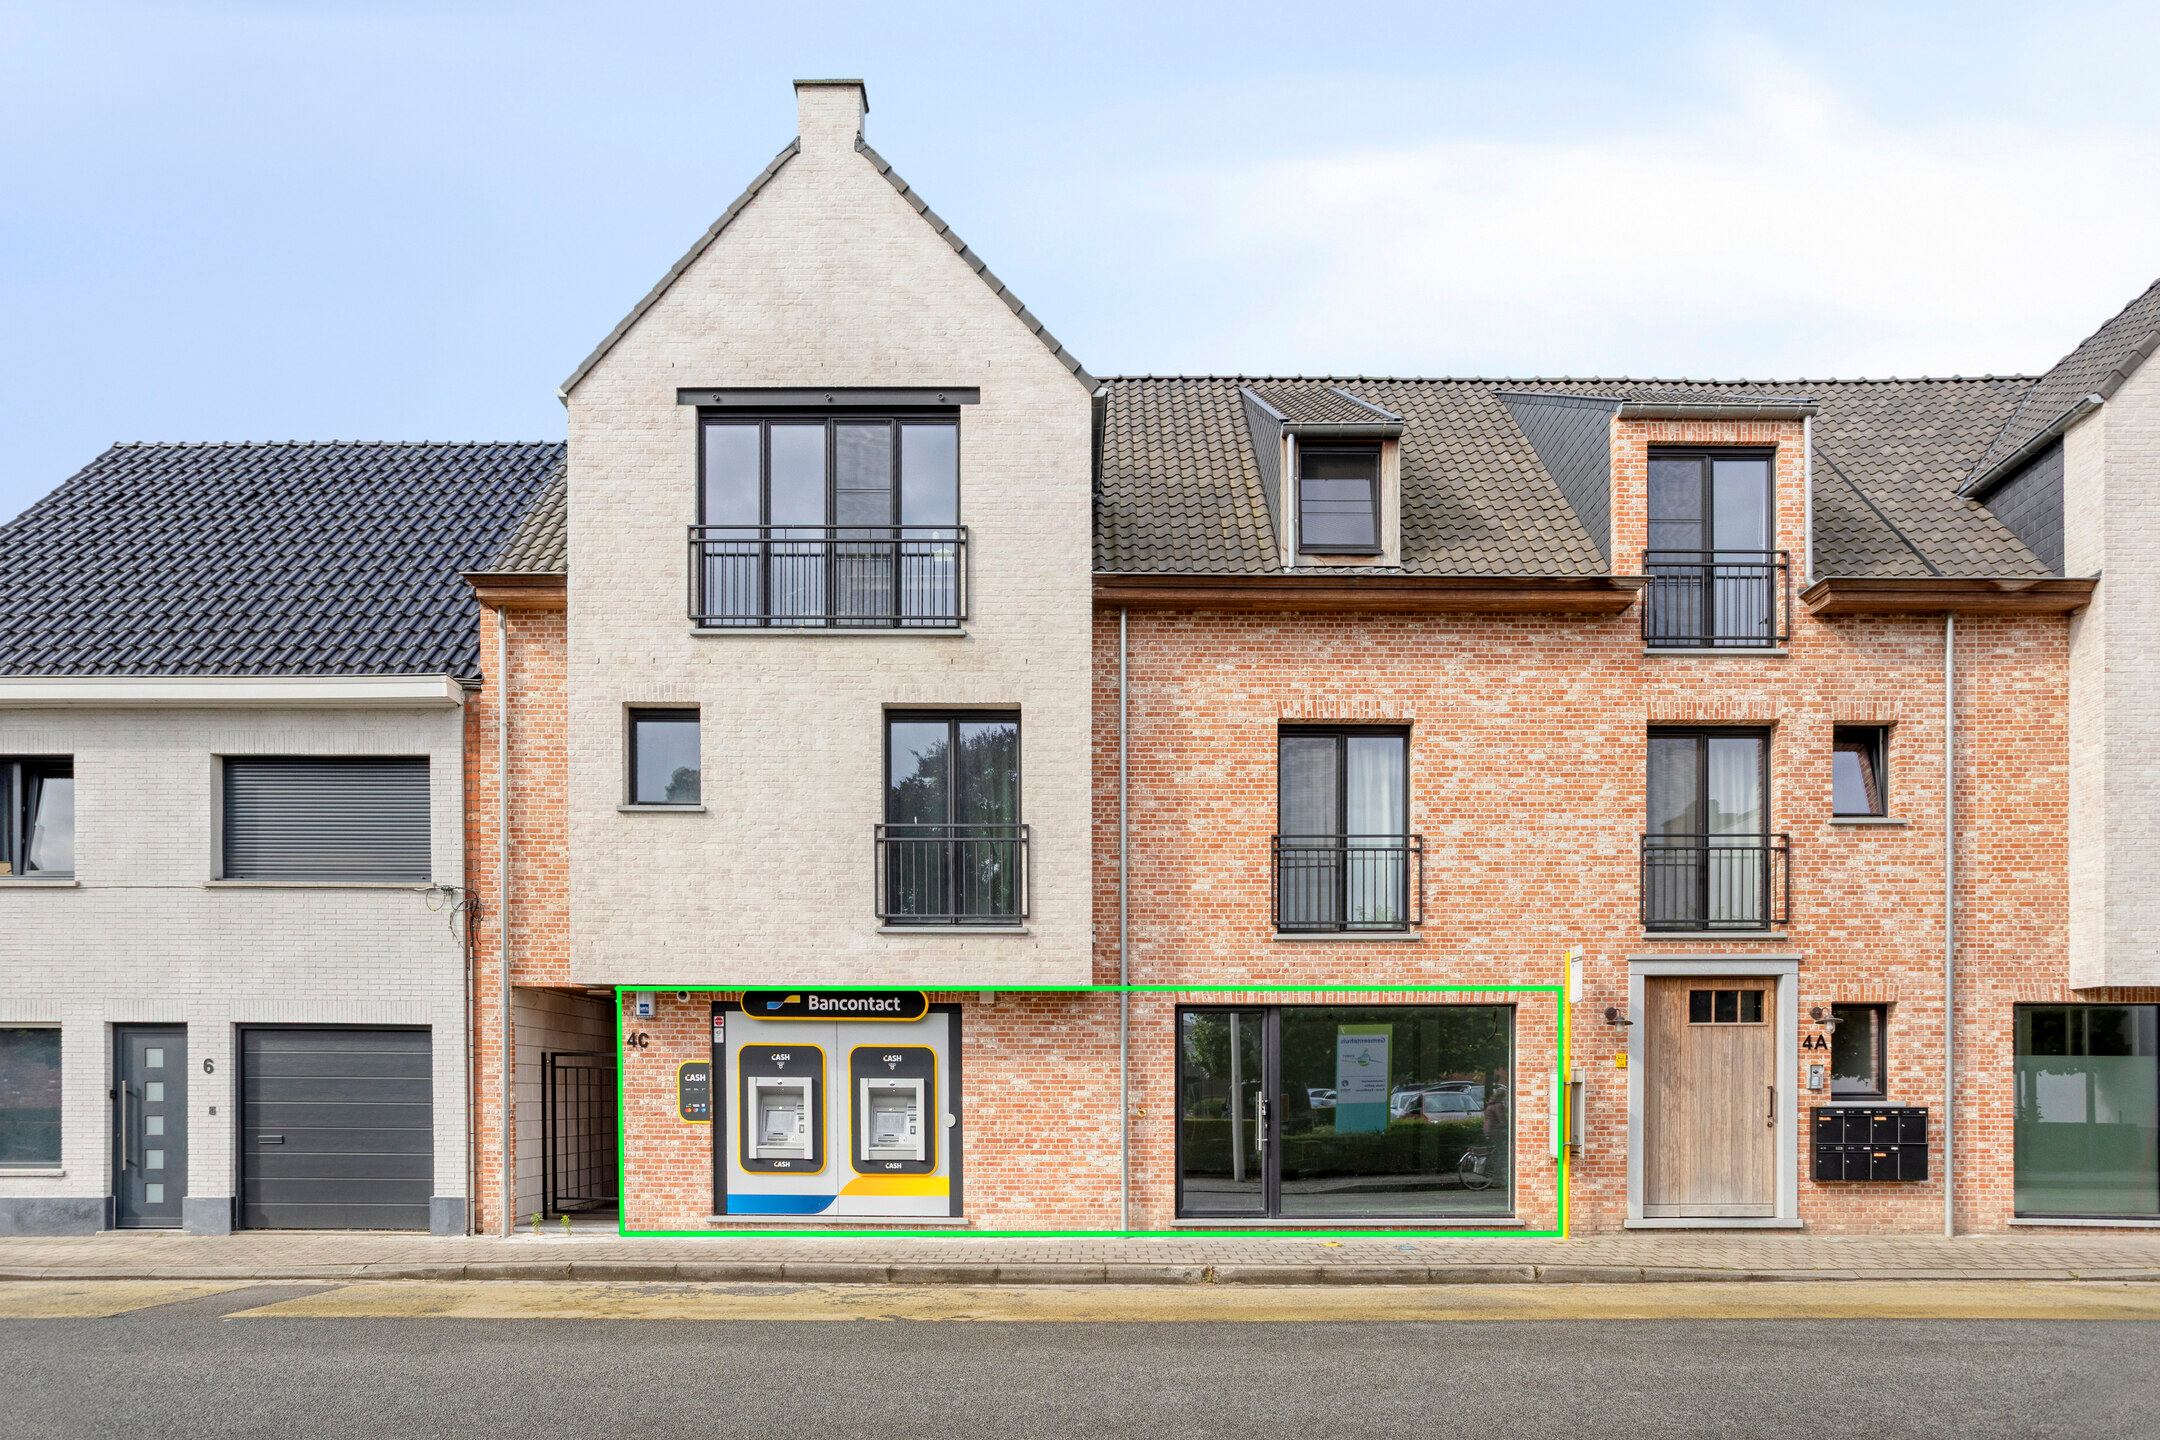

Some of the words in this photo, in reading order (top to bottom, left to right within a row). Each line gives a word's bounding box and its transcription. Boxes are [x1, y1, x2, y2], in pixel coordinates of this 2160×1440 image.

[808, 994, 901, 1011] Bancontact
[627, 1032, 649, 1048] 4C
[1802, 1034, 1828, 1050] 4A
[771, 1053, 791, 1061] CASH
[882, 1054, 902, 1062] CASH
[203, 1058, 215, 1074] 6
[684, 1073, 706, 1082] CASH
[773, 1160, 791, 1168] CASH
